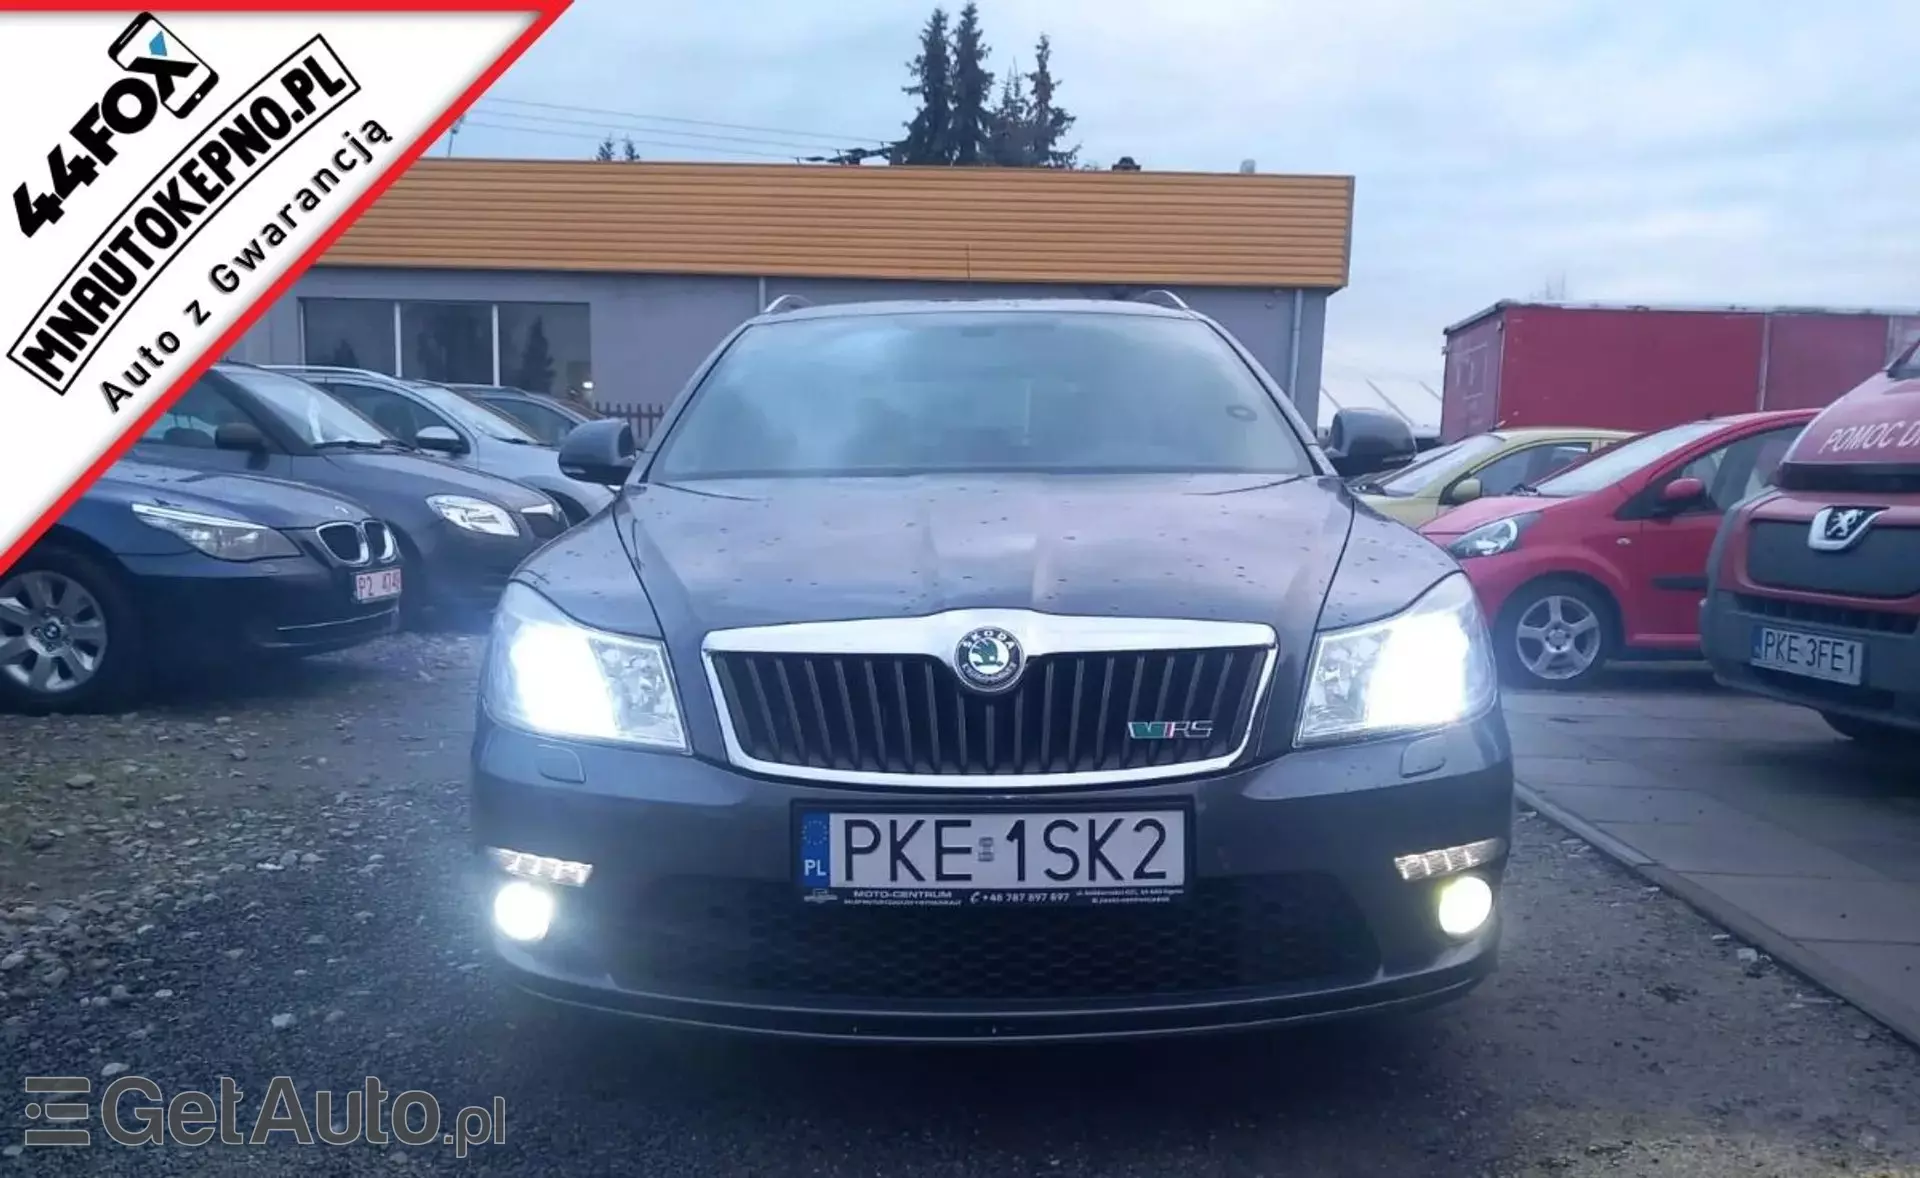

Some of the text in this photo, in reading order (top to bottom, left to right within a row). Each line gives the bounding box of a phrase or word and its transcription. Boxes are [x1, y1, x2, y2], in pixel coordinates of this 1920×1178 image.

[1818, 420, 1906, 454] POMOC
[1764, 630, 1799, 664] PKE
[1805, 638, 1856, 676] 3FE1
[843, 817, 1168, 882] PKE 1SK2
[803, 858, 827, 877] PL
[853, 889, 953, 899] MOTO-CENTRUM
